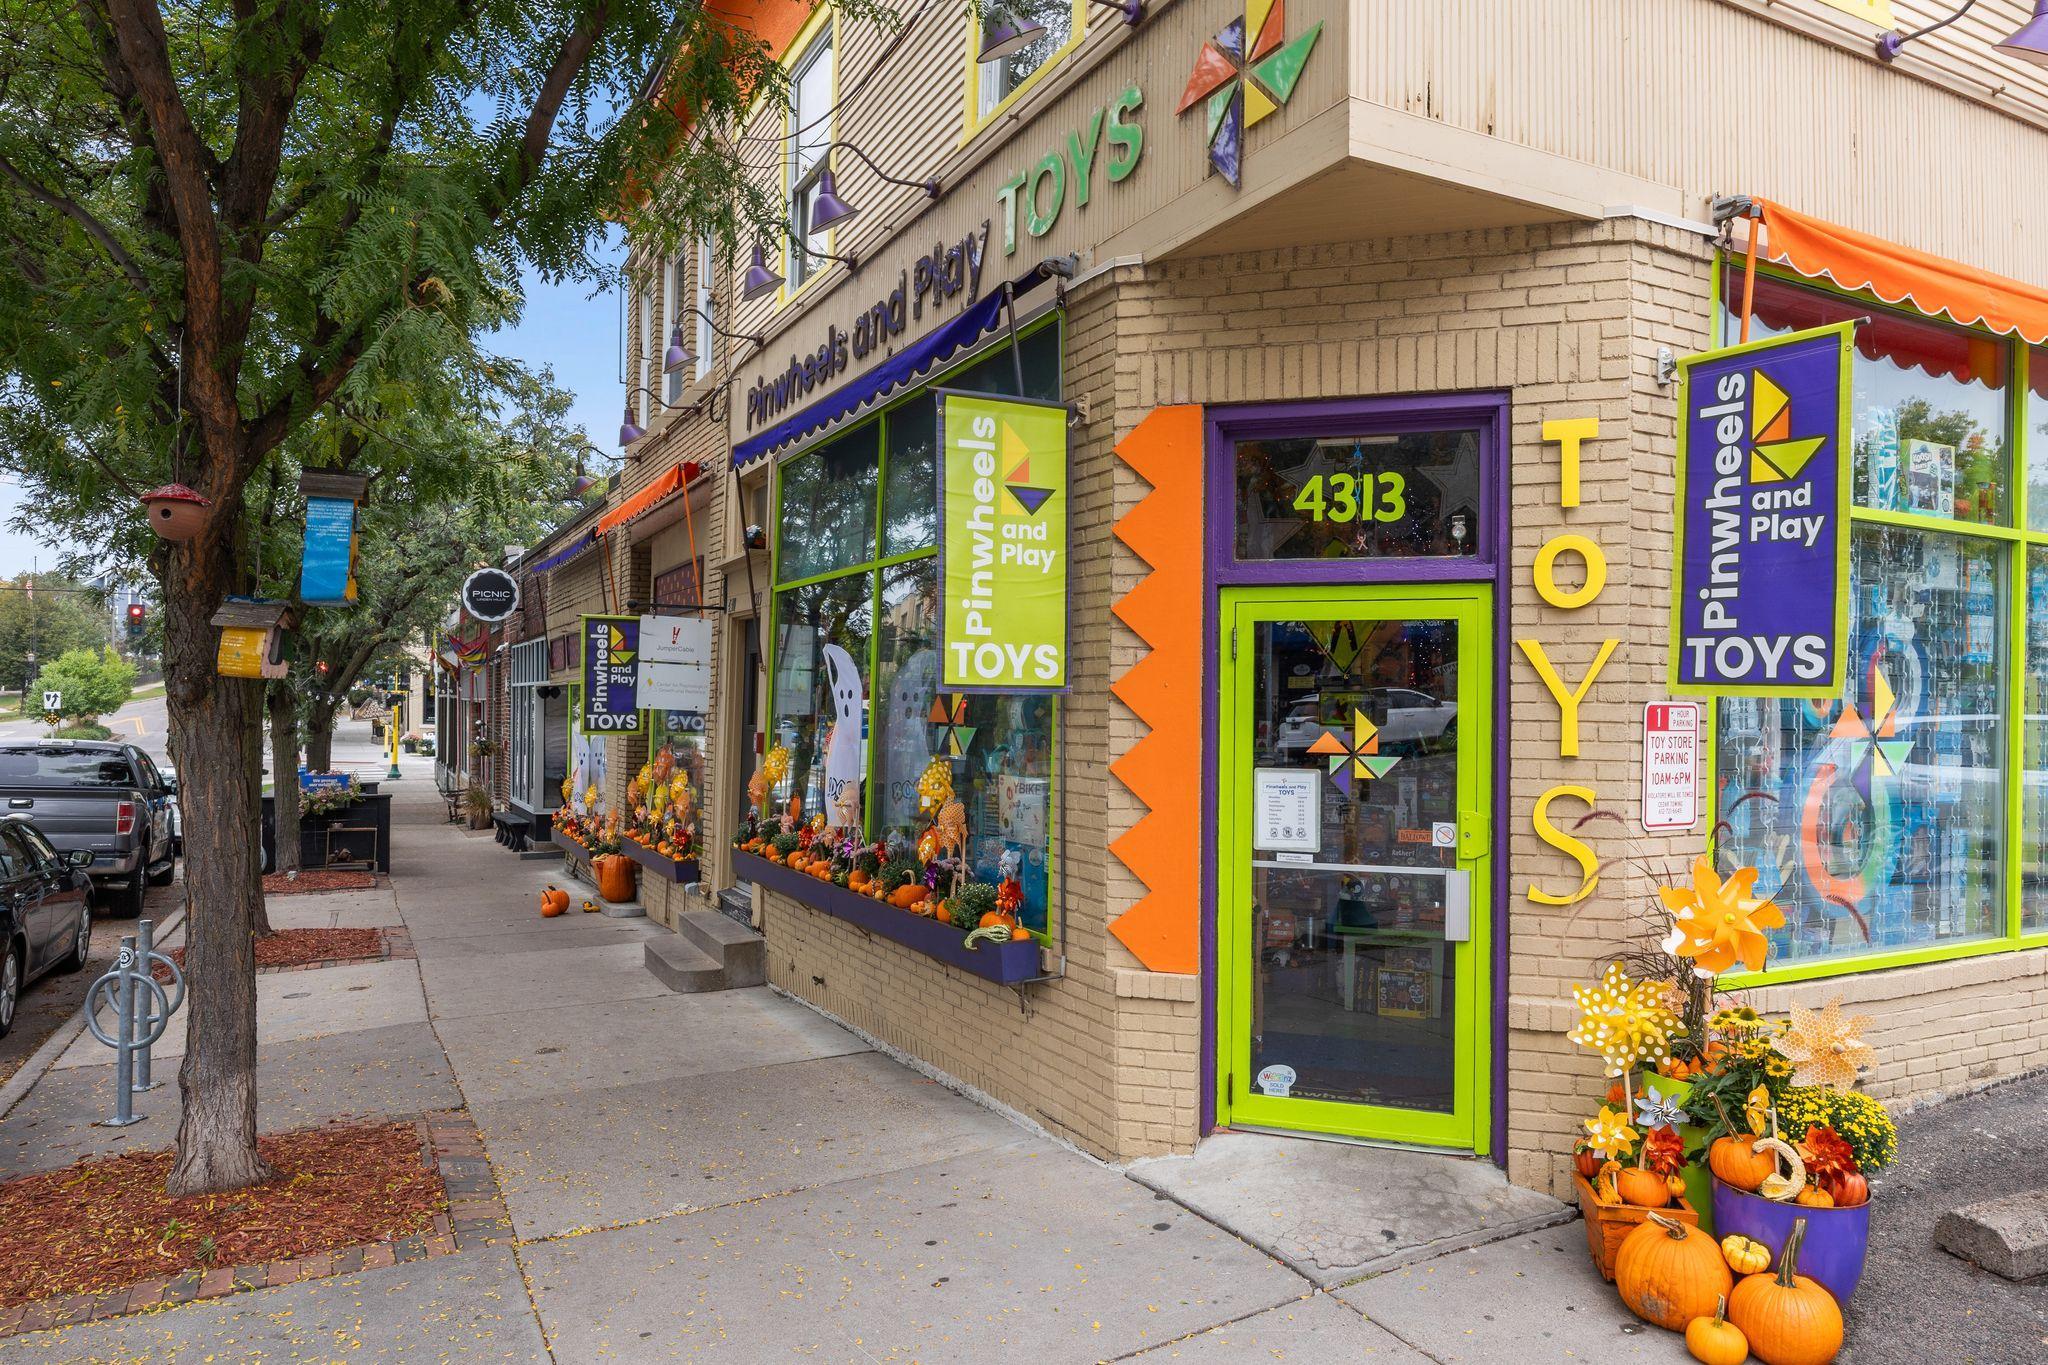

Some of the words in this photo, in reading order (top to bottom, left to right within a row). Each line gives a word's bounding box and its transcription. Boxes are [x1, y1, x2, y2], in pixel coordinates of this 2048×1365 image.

[747, 324, 848, 430] Pinwheels
[852, 268, 906, 359] and
[913, 218, 990, 320] Play
[996, 86, 1143, 256] TOYS
[1293, 472, 1406, 523] 4313
[1700, 373, 1746, 629] Pinwheels
[1751, 482, 1811, 510] and
[957, 416, 996, 636] Pinwheels
[1002, 521, 1047, 541] and
[1751, 515, 1824, 547] Play
[1001, 543, 1056, 574] Play
[472, 590, 511, 598] PICNIC
[590, 624, 608, 712] Pinwheels
[951, 641, 1059, 679] TOYS
[1687, 635, 1826, 678] TOYS
[610, 675, 636, 687] Play
[611, 665, 631, 673] and
[587, 714, 637, 729] TOYS
[1656, 708, 1661, 728] 1
[1673, 719, 1693, 727] PARKING
[1651, 737, 1665, 749] TOY
[1668, 736, 1692, 748] STORE
[1654, 752, 1689, 765] PARKING
[1652, 772, 1691, 785] 10AM-6PM
